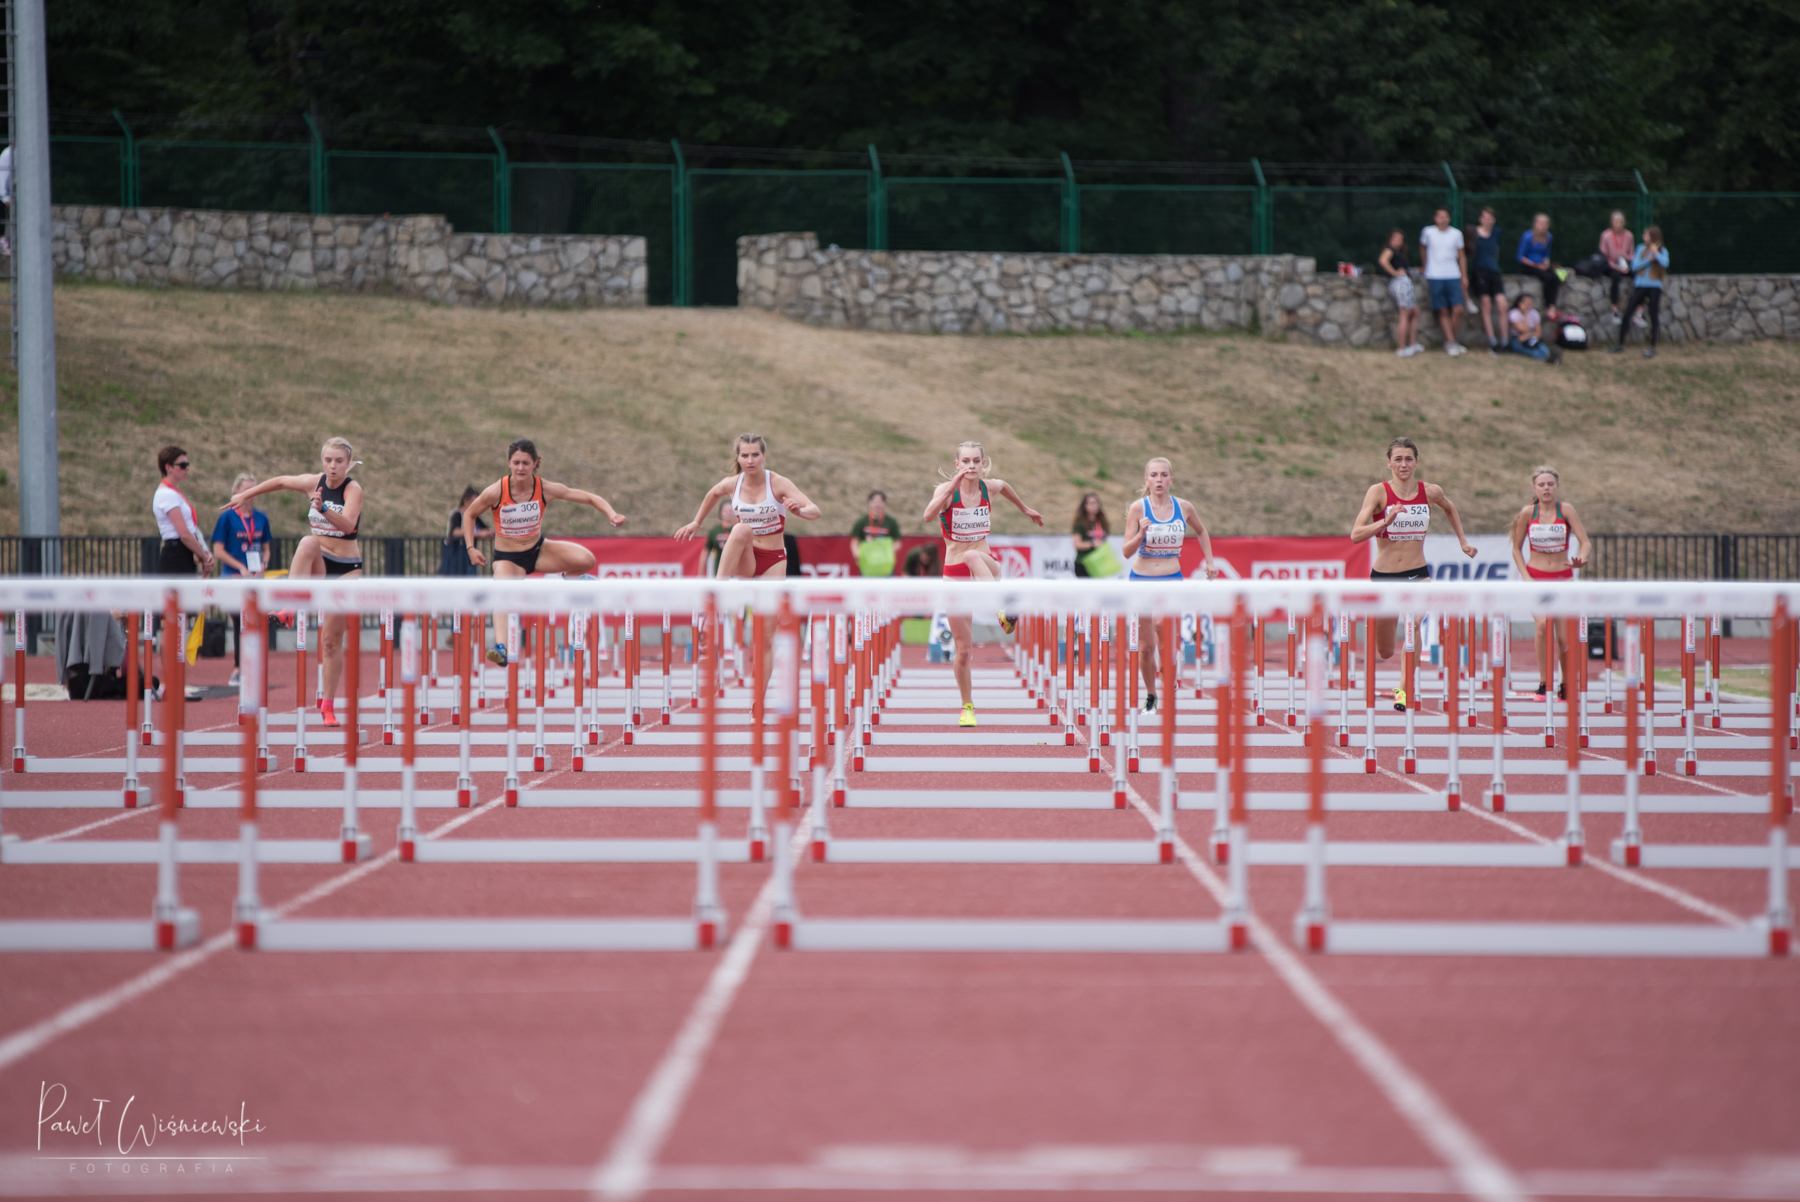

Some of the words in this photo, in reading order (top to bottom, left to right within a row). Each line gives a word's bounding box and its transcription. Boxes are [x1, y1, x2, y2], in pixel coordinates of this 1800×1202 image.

[520, 502, 539, 513] 300
[758, 505, 778, 515] 273
[973, 507, 989, 517] 410
[1410, 505, 1428, 515] 524
[953, 520, 990, 530] ZACZKIEWICZ
[1166, 524, 1184, 533] 701
[1392, 520, 1425, 528] KIEPURA
[1549, 525, 1565, 534] 405
[1151, 534, 1177, 545] KŁOS
